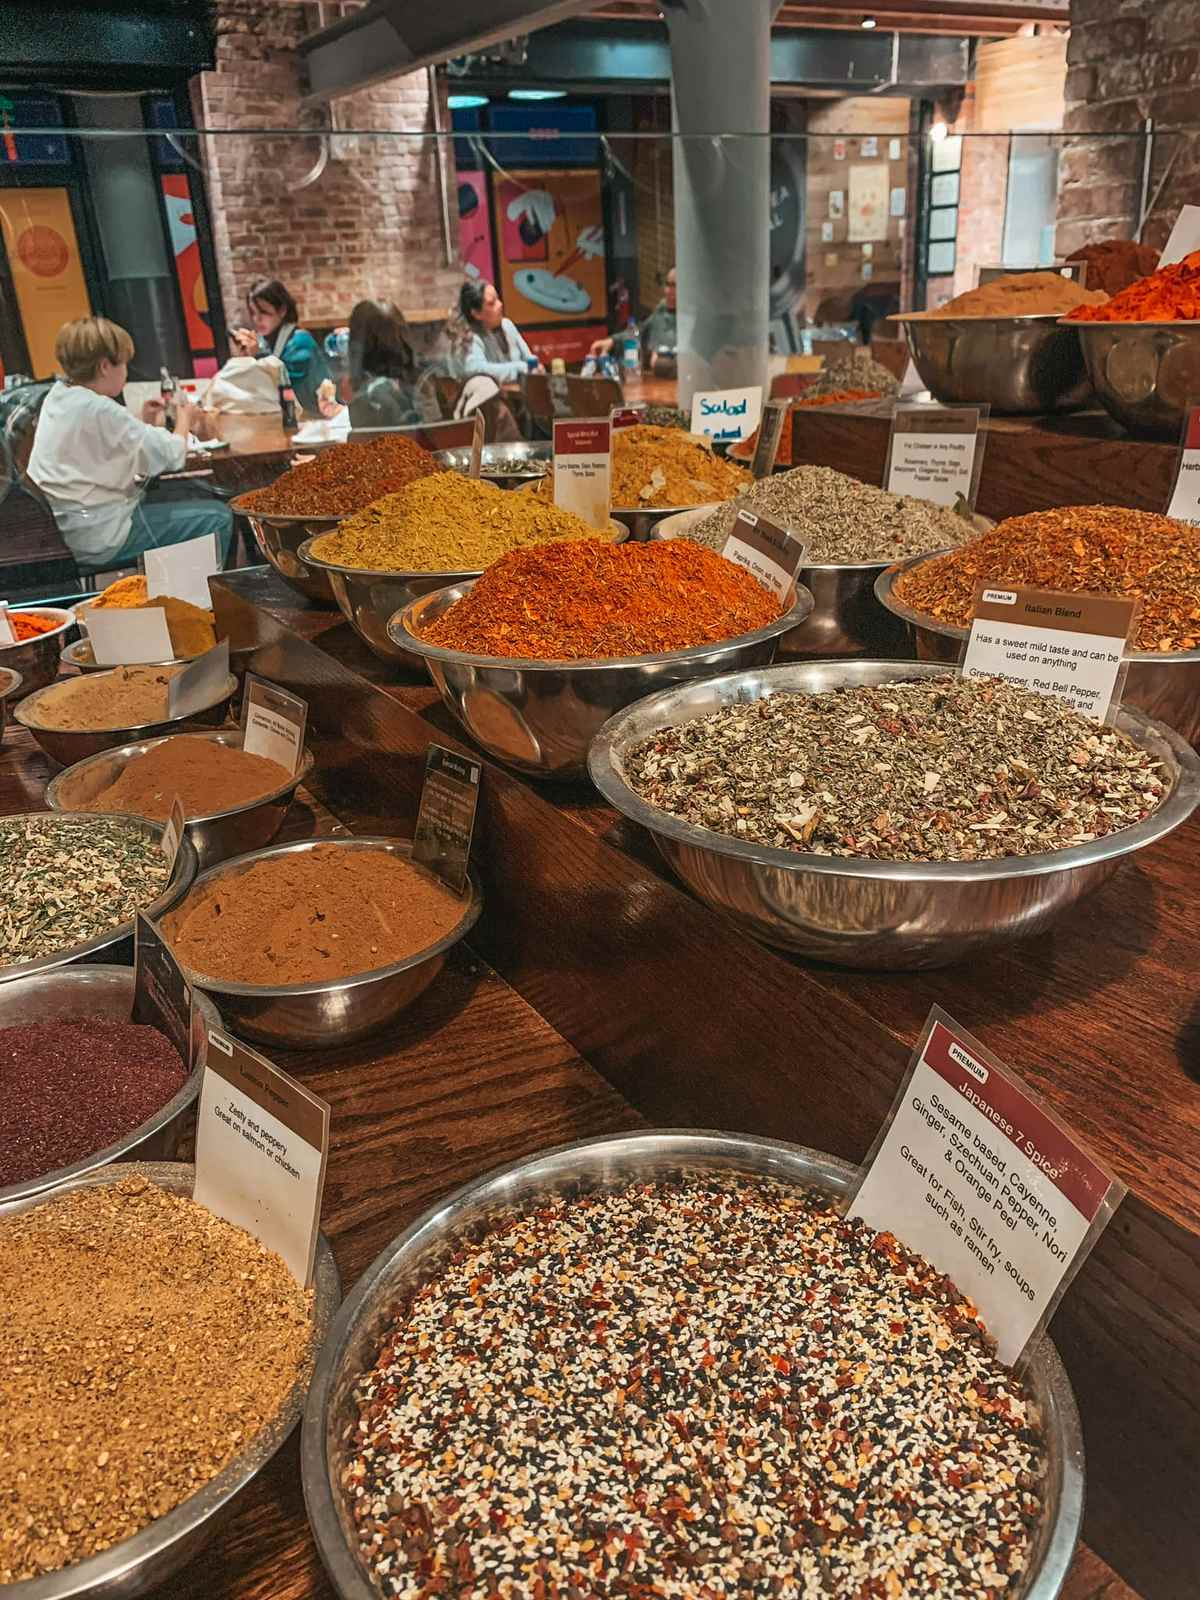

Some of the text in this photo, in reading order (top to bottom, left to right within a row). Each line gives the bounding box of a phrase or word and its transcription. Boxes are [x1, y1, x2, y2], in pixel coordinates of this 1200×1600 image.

[700, 398, 747, 416] Salad
[986, 593, 1012, 601] PREMIUM
[1025, 604, 1082, 618] Italian Blend
[976, 633, 992, 644] Has
[1003, 639, 1027, 649] sweet
[1029, 642, 1048, 652] mild
[1049, 645, 1070, 656] taste
[1072, 648, 1088, 658] and
[1090, 651, 1105, 660] can
[1108, 654, 1119, 663] be
[1006, 652, 1078, 671] used on anything
[1033, 679, 1050, 690] Red
[1052, 682, 1068, 693] Bell
[1077, 700, 1094, 711] and
[952, 1048, 985, 1080] PREMIUM
[214, 1105, 301, 1181] Great on salmon or chicken
[228, 1102, 287, 1156] Zesty and peppery
[958, 1082, 1059, 1181] Japanese 7 Spice
[912, 1097, 1068, 1264] Ginger, Szechuan Pepper, Nori
[930, 1094, 1058, 1233] Sesame based, Cayenne,
[944, 1150, 1018, 1231] & Orange Peel
[900, 1145, 1036, 1302] Great for Fish, Stir fry, soups
[925, 1192, 996, 1275] such as ramen
